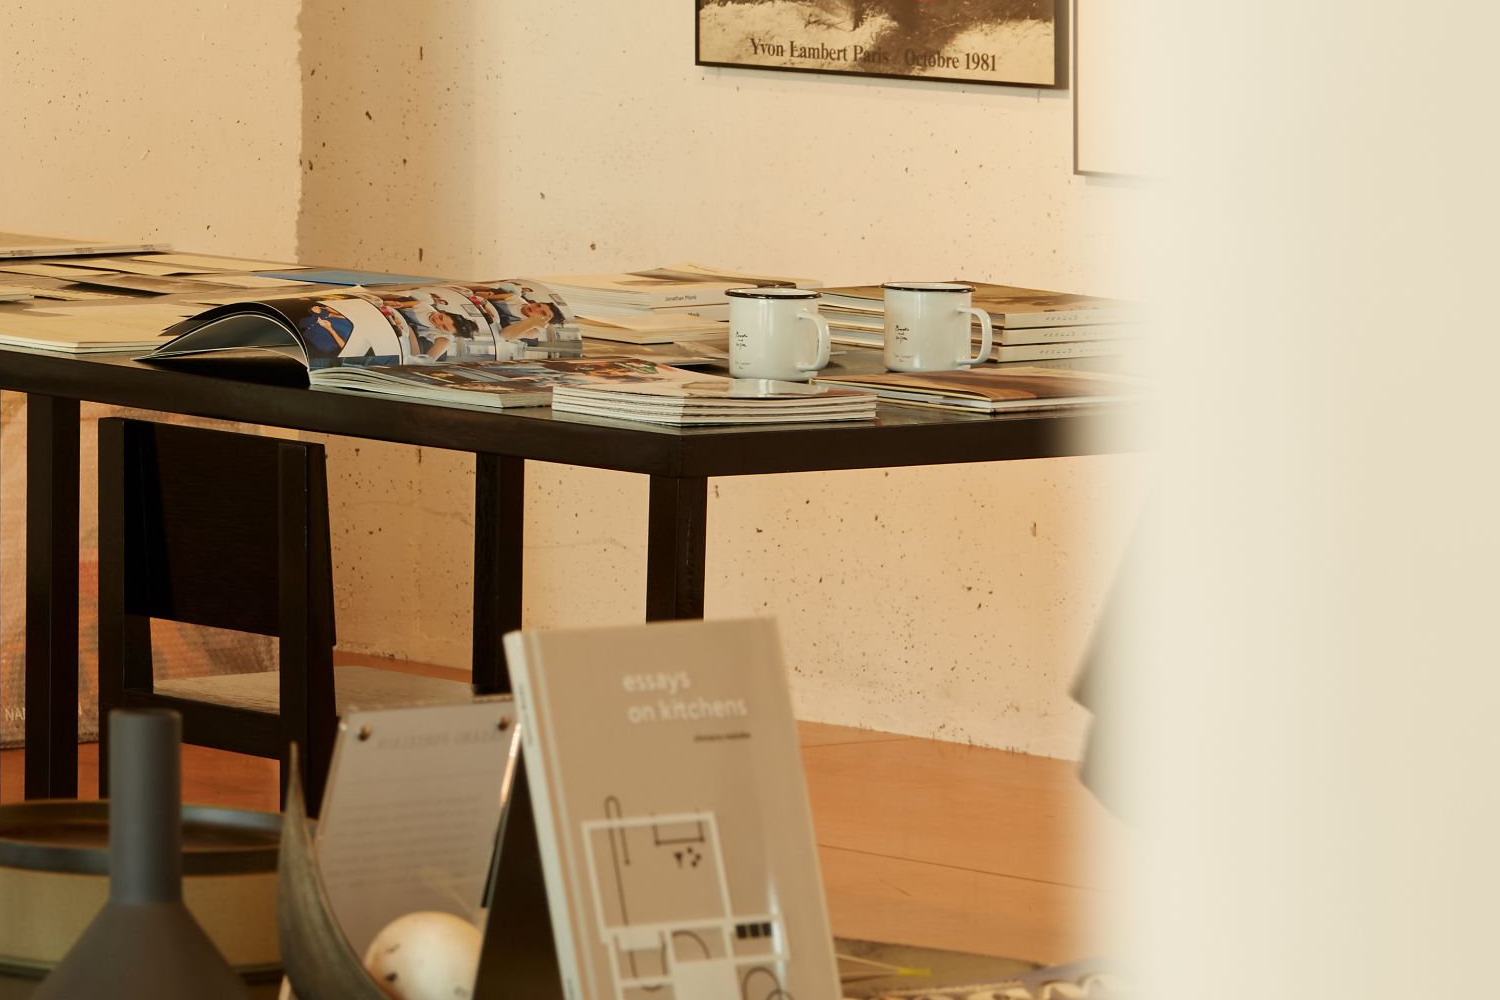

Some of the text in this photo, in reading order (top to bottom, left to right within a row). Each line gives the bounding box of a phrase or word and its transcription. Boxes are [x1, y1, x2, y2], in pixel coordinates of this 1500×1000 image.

[750, 38, 784, 56] Yvon
[790, 41, 848, 61] Lambert
[905, 48, 960, 69] Octobre
[964, 52, 996, 72] 1981
[622, 671, 692, 695] essays
[627, 697, 748, 724] on kitchens
